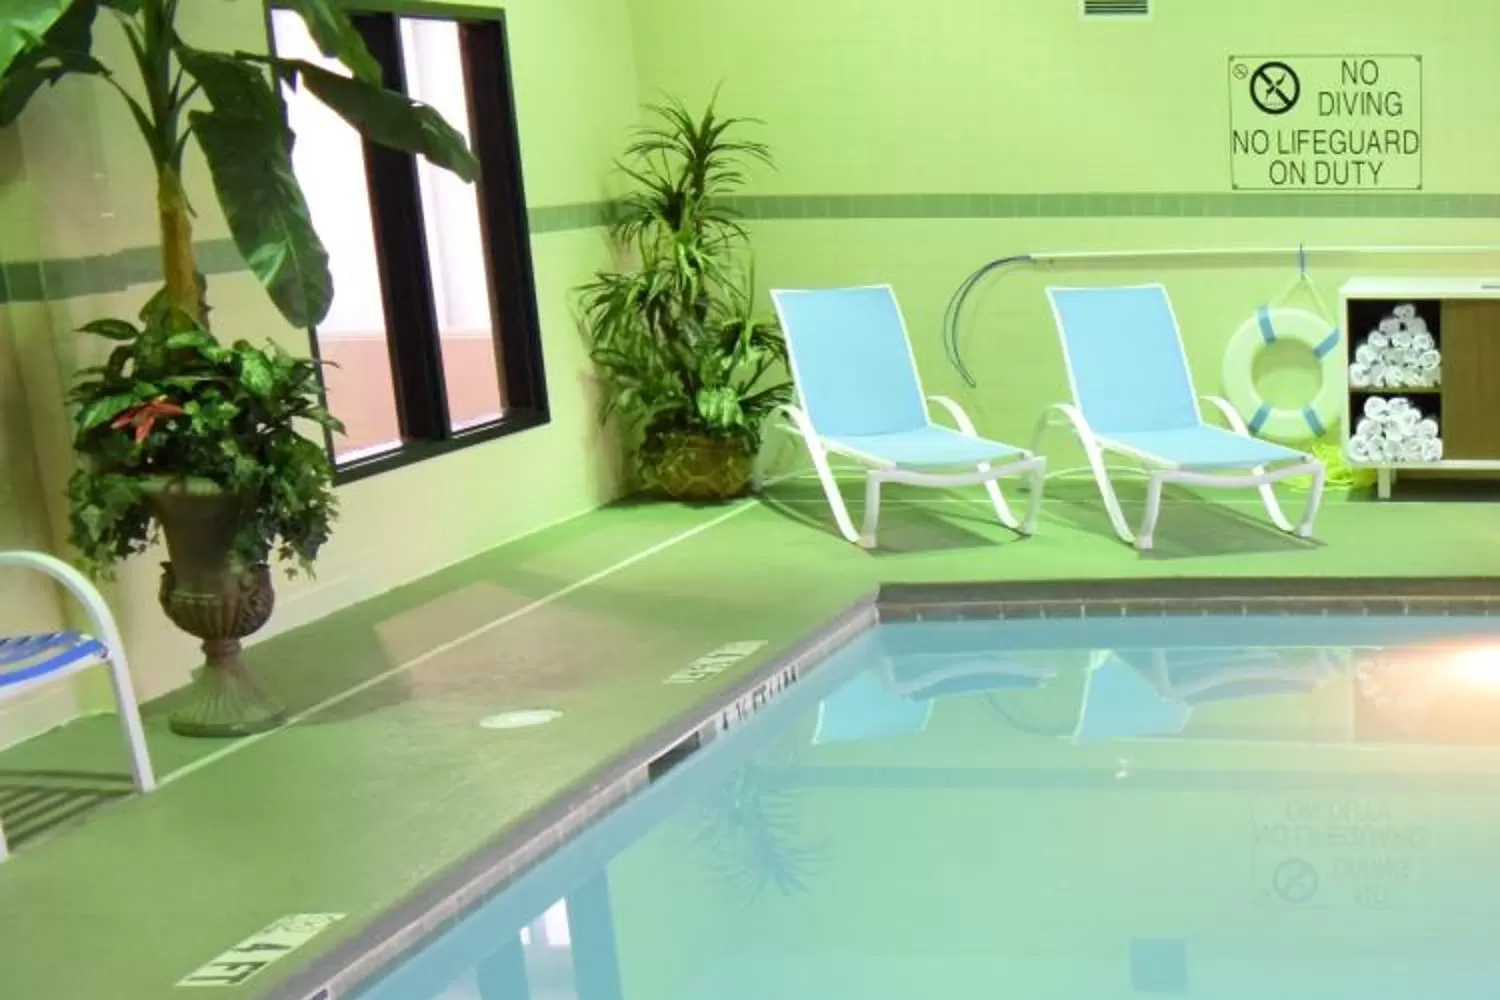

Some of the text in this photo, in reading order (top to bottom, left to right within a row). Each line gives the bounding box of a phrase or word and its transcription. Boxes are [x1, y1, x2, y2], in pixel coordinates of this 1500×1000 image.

[1341, 59, 1379, 85] NO
[1318, 91, 1403, 116] DIVING
[1233, 129, 1420, 155] NO LIFEGUARD
[1269, 160, 1383, 185] ON DUTY
